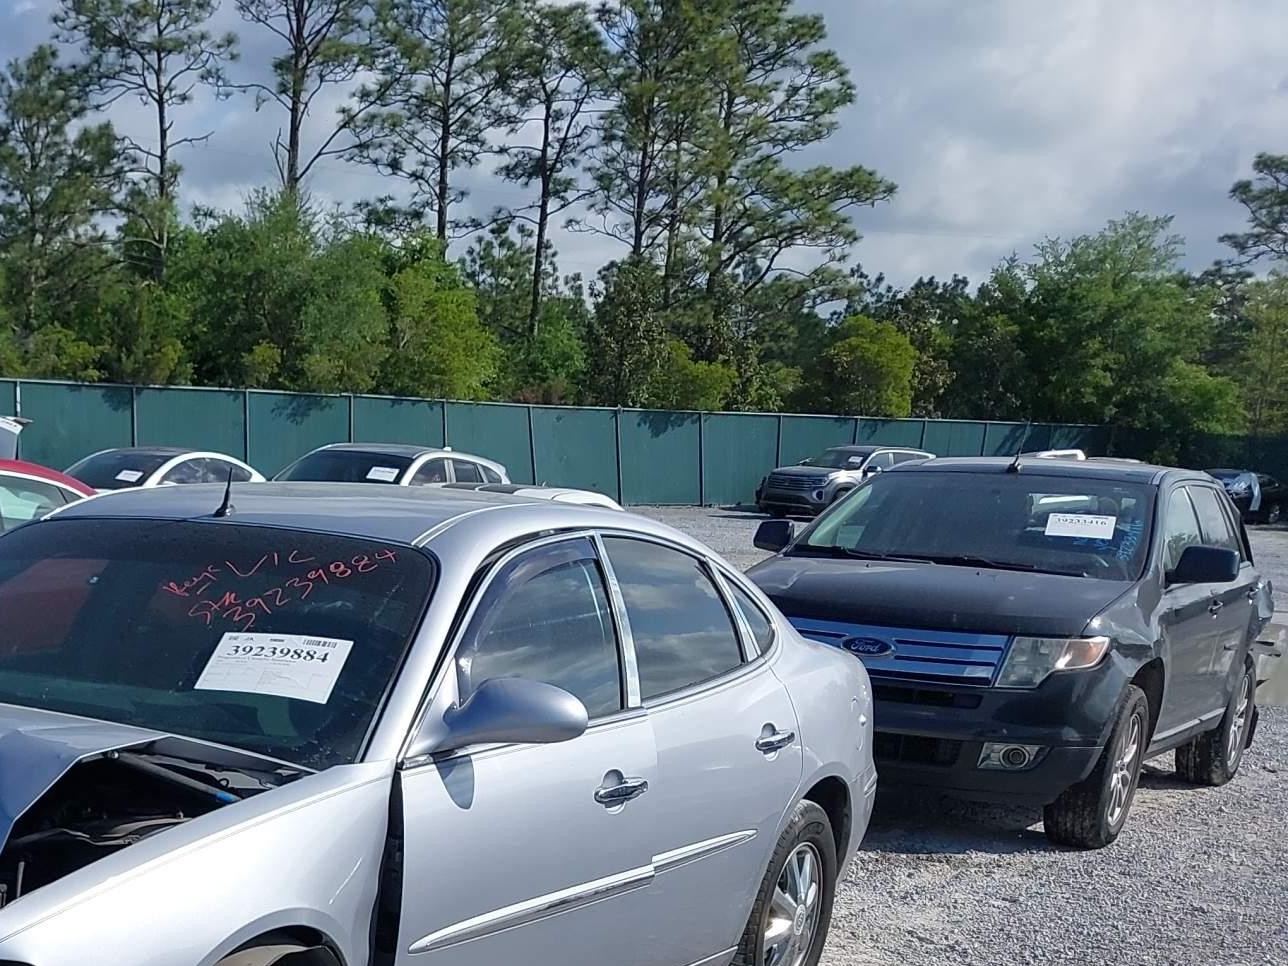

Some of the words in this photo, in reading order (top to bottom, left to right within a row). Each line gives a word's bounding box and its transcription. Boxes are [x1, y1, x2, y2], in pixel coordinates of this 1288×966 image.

[222, 549, 397, 633] 39239884
[226, 644, 331, 663] 39239884
[850, 639, 882, 652] Ford
